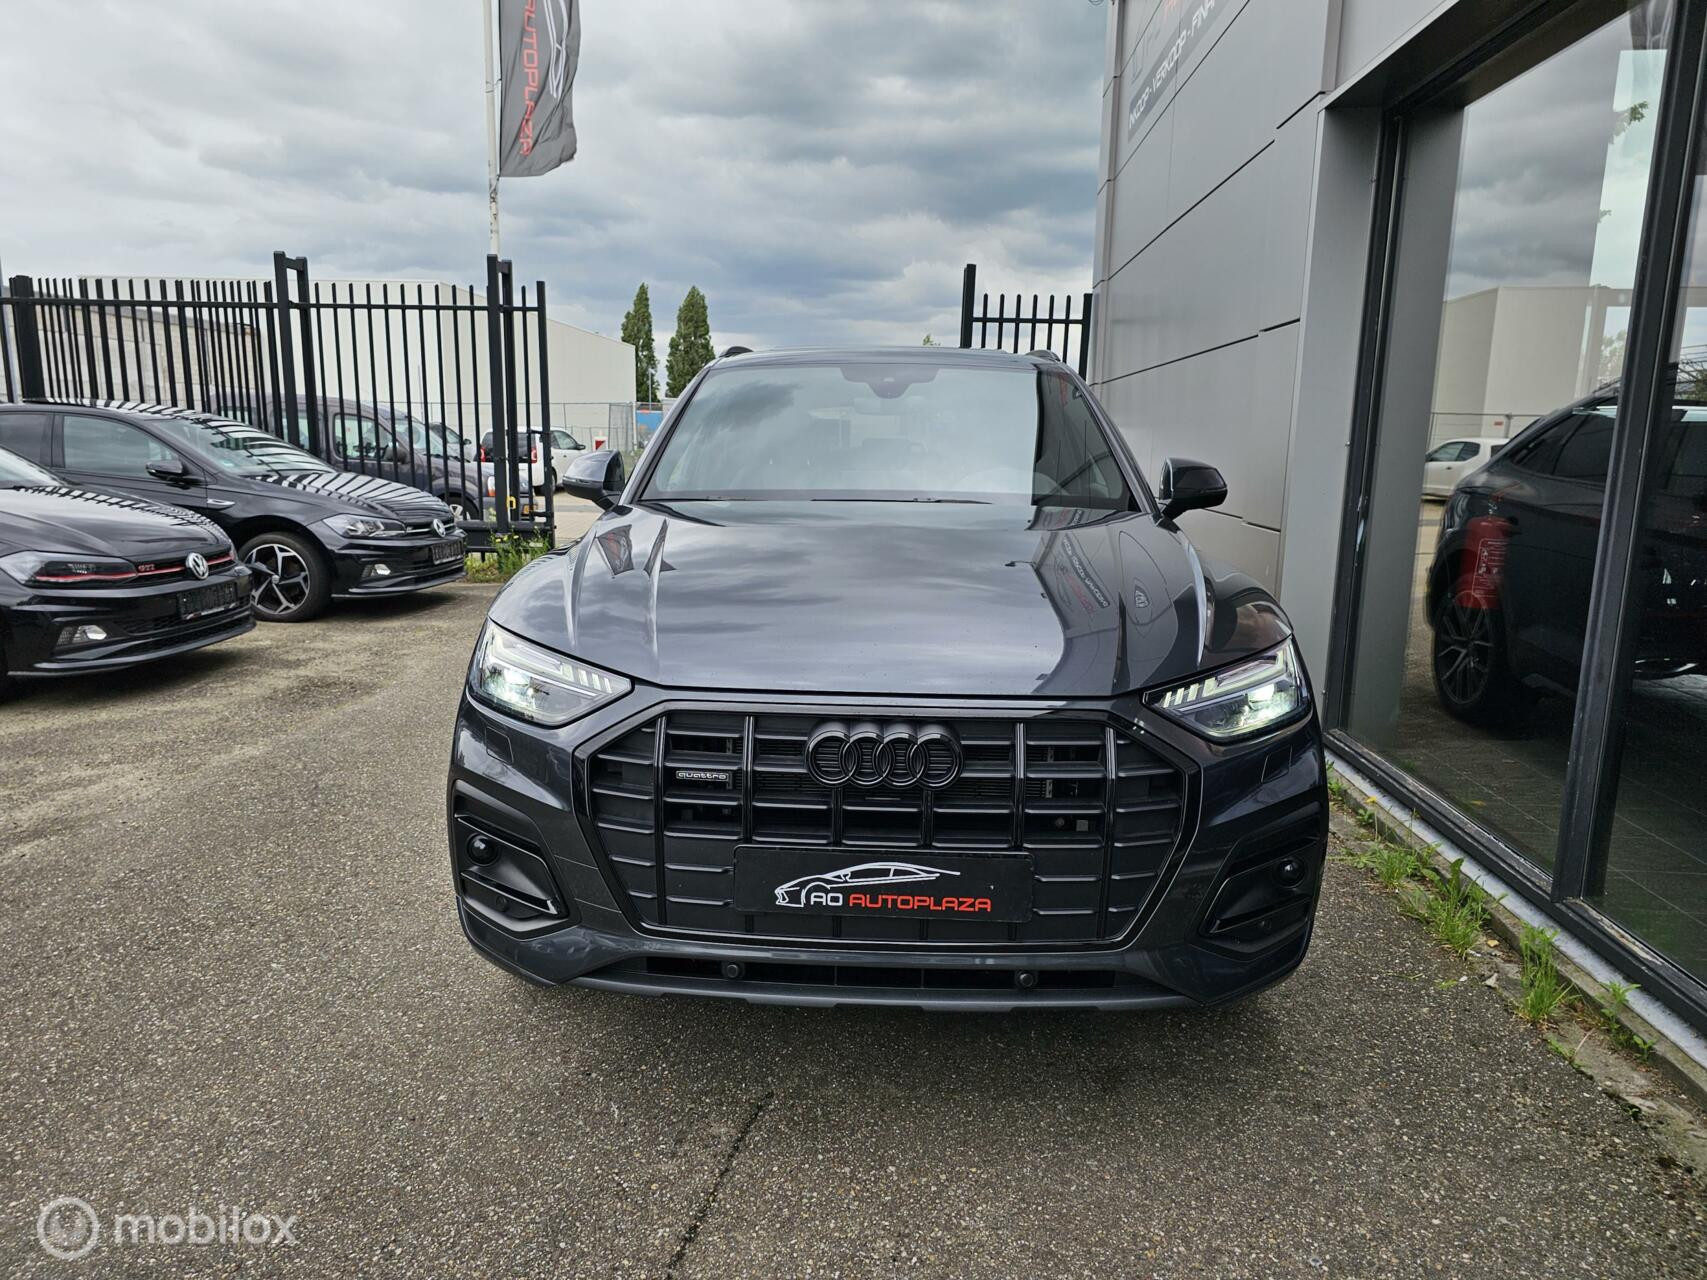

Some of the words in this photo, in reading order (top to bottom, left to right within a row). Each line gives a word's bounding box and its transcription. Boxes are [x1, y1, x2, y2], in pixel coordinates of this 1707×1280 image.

[138, 563, 156, 572] GTI
[678, 772, 727, 780] quattro
[849, 893, 992, 913] AUTOPLAZA
